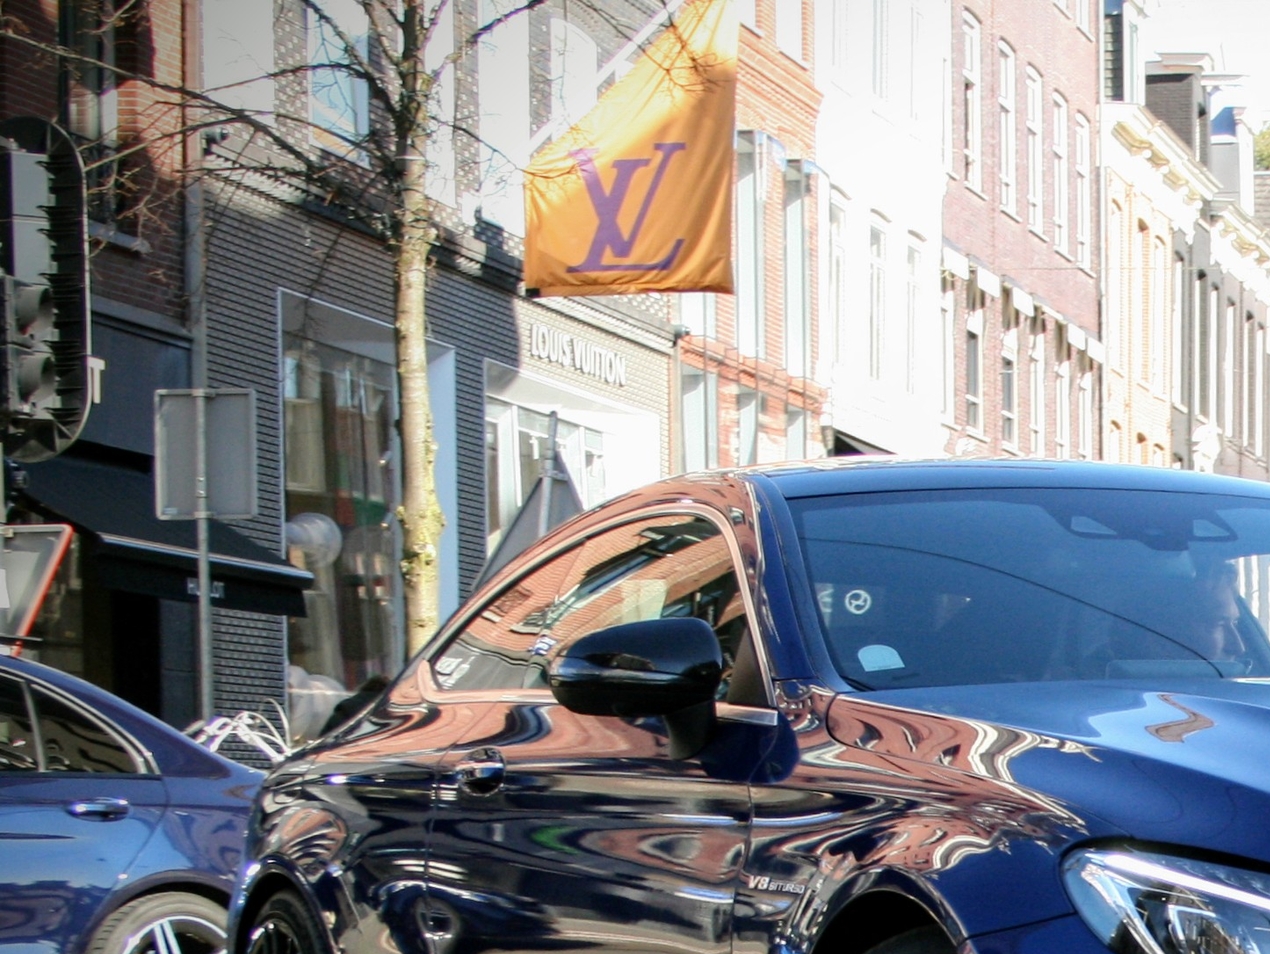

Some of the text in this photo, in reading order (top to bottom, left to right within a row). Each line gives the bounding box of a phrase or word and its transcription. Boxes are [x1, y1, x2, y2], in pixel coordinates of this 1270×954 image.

[531, 323, 627, 386] LOUIS VUITTON
[748, 875, 770, 890] V8
